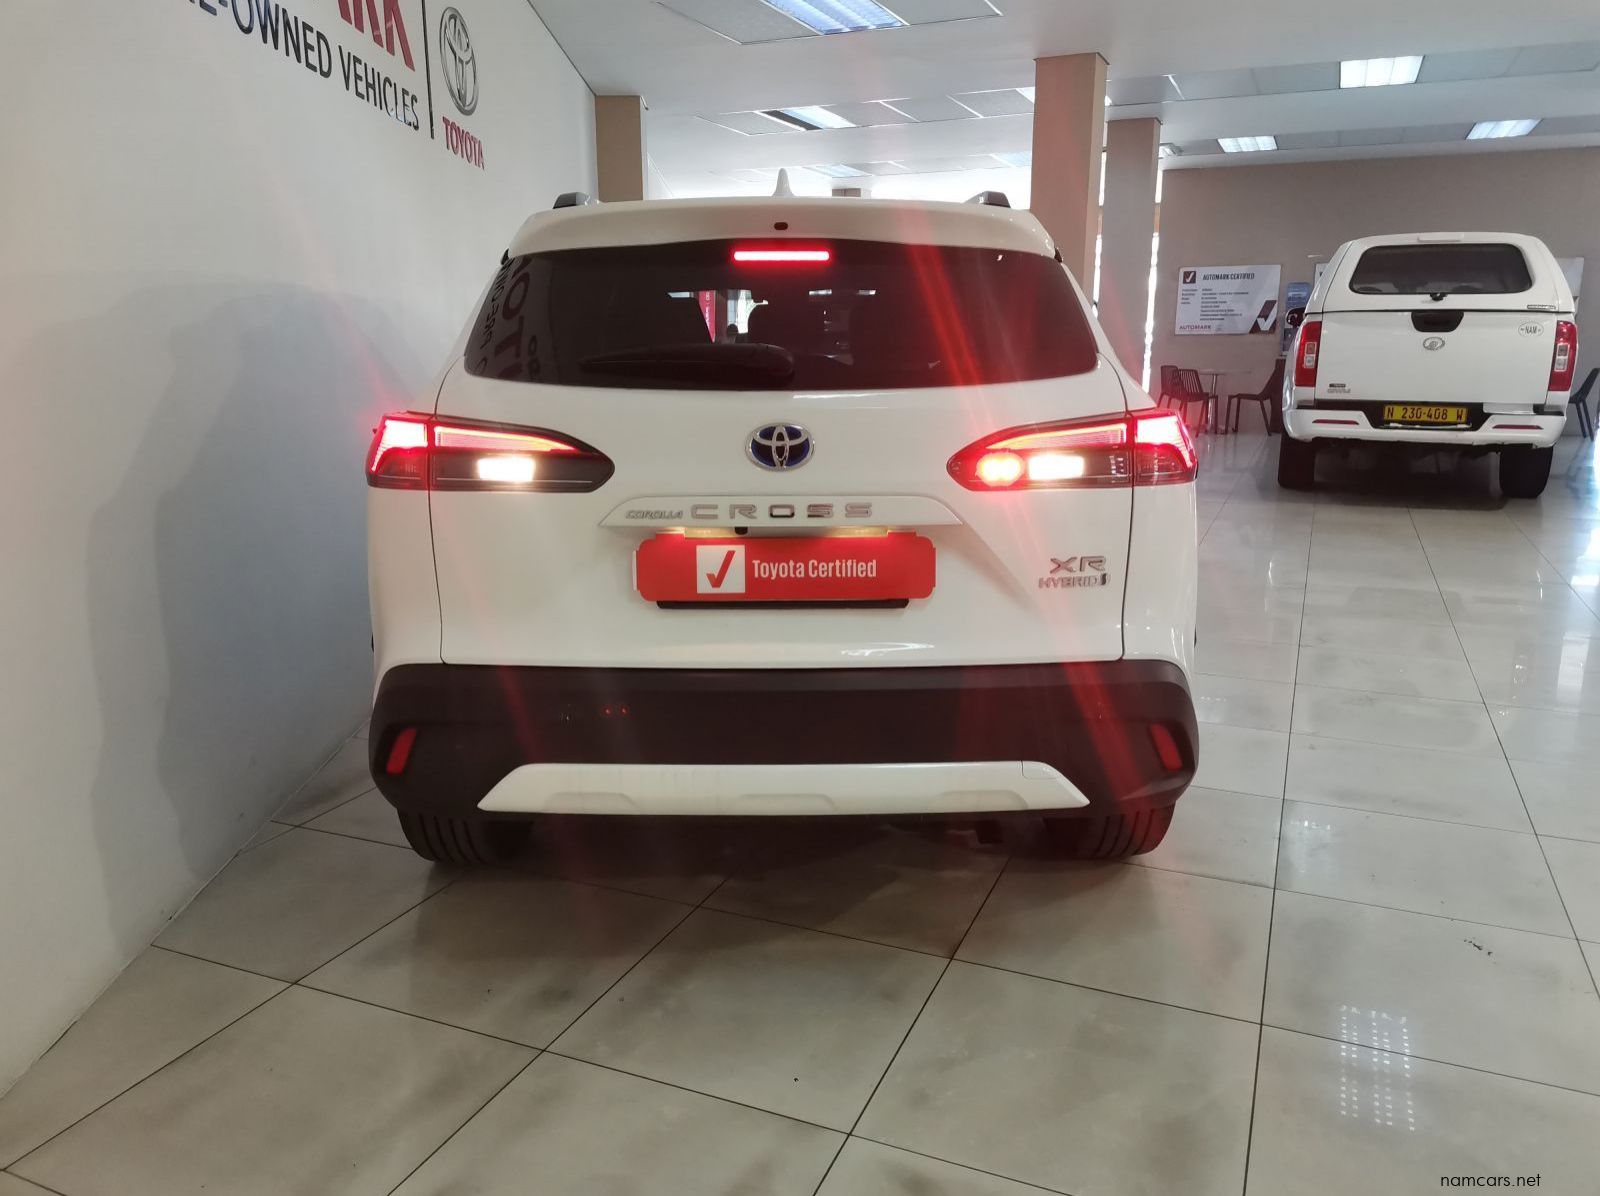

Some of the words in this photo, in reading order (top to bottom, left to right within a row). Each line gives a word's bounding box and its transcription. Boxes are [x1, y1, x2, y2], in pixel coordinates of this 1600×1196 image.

[338, 45, 420, 131] VEHICLES
[442, 116, 485, 170] TOYOTA
[1387, 407, 1394, 419] N
[1401, 407, 1448, 420] 230-408
[625, 509, 684, 520] COROLLA
[691, 502, 873, 520] CROSS
[752, 559, 805, 581] Toyota
[808, 559, 877, 578] Certified
[1049, 556, 1106, 574] XR
[1038, 576, 1098, 589] HYBRID
